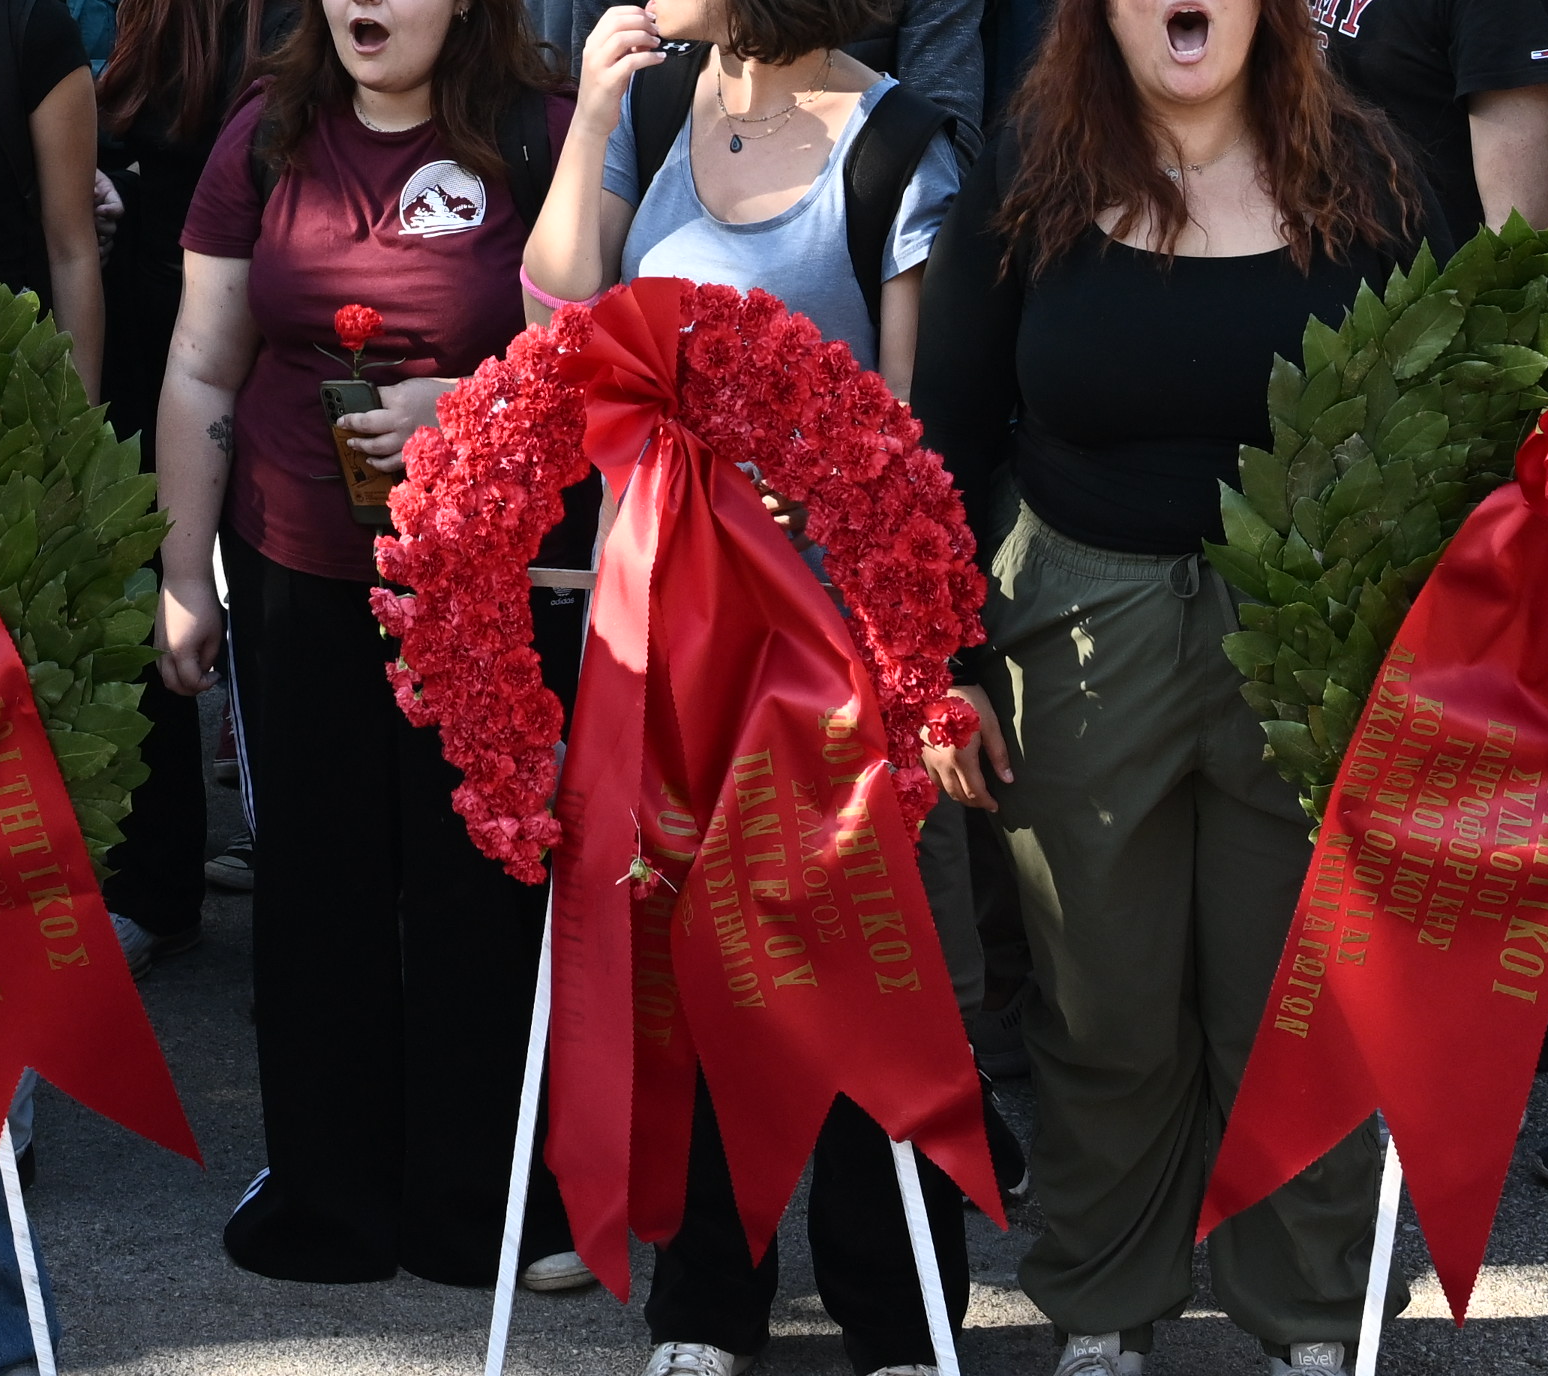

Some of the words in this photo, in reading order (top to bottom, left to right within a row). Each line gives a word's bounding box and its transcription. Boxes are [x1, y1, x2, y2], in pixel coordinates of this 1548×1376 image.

[1339, 642, 1415, 802] ΔΑΣΚΑΛΩΝ
[731, 749, 818, 990] ΠΑΝΤΕΙΟΥ
[790, 779, 846, 944] ΣΥΛΛΟΓΟΣ
[817, 708, 922, 995] ΦΟΙΤΗΤΙΚΟΣ
[1335, 695, 1444, 967] ΚΟΙΝΩΝΙΟΛΟΓΙΑΣ
[1384, 735, 1475, 923] ΓΕΩΛΟΓΙΚΟΥ
[1417, 719, 1517, 952] ΠΛΗΡΟΦΟΡΙΚΗΣ
[1471, 765, 1543, 923] ΣΥΛΛΟΓΟΙ
[1273, 832, 1355, 1039] ΝΗΠΙΑΓΩΓΩΝ
